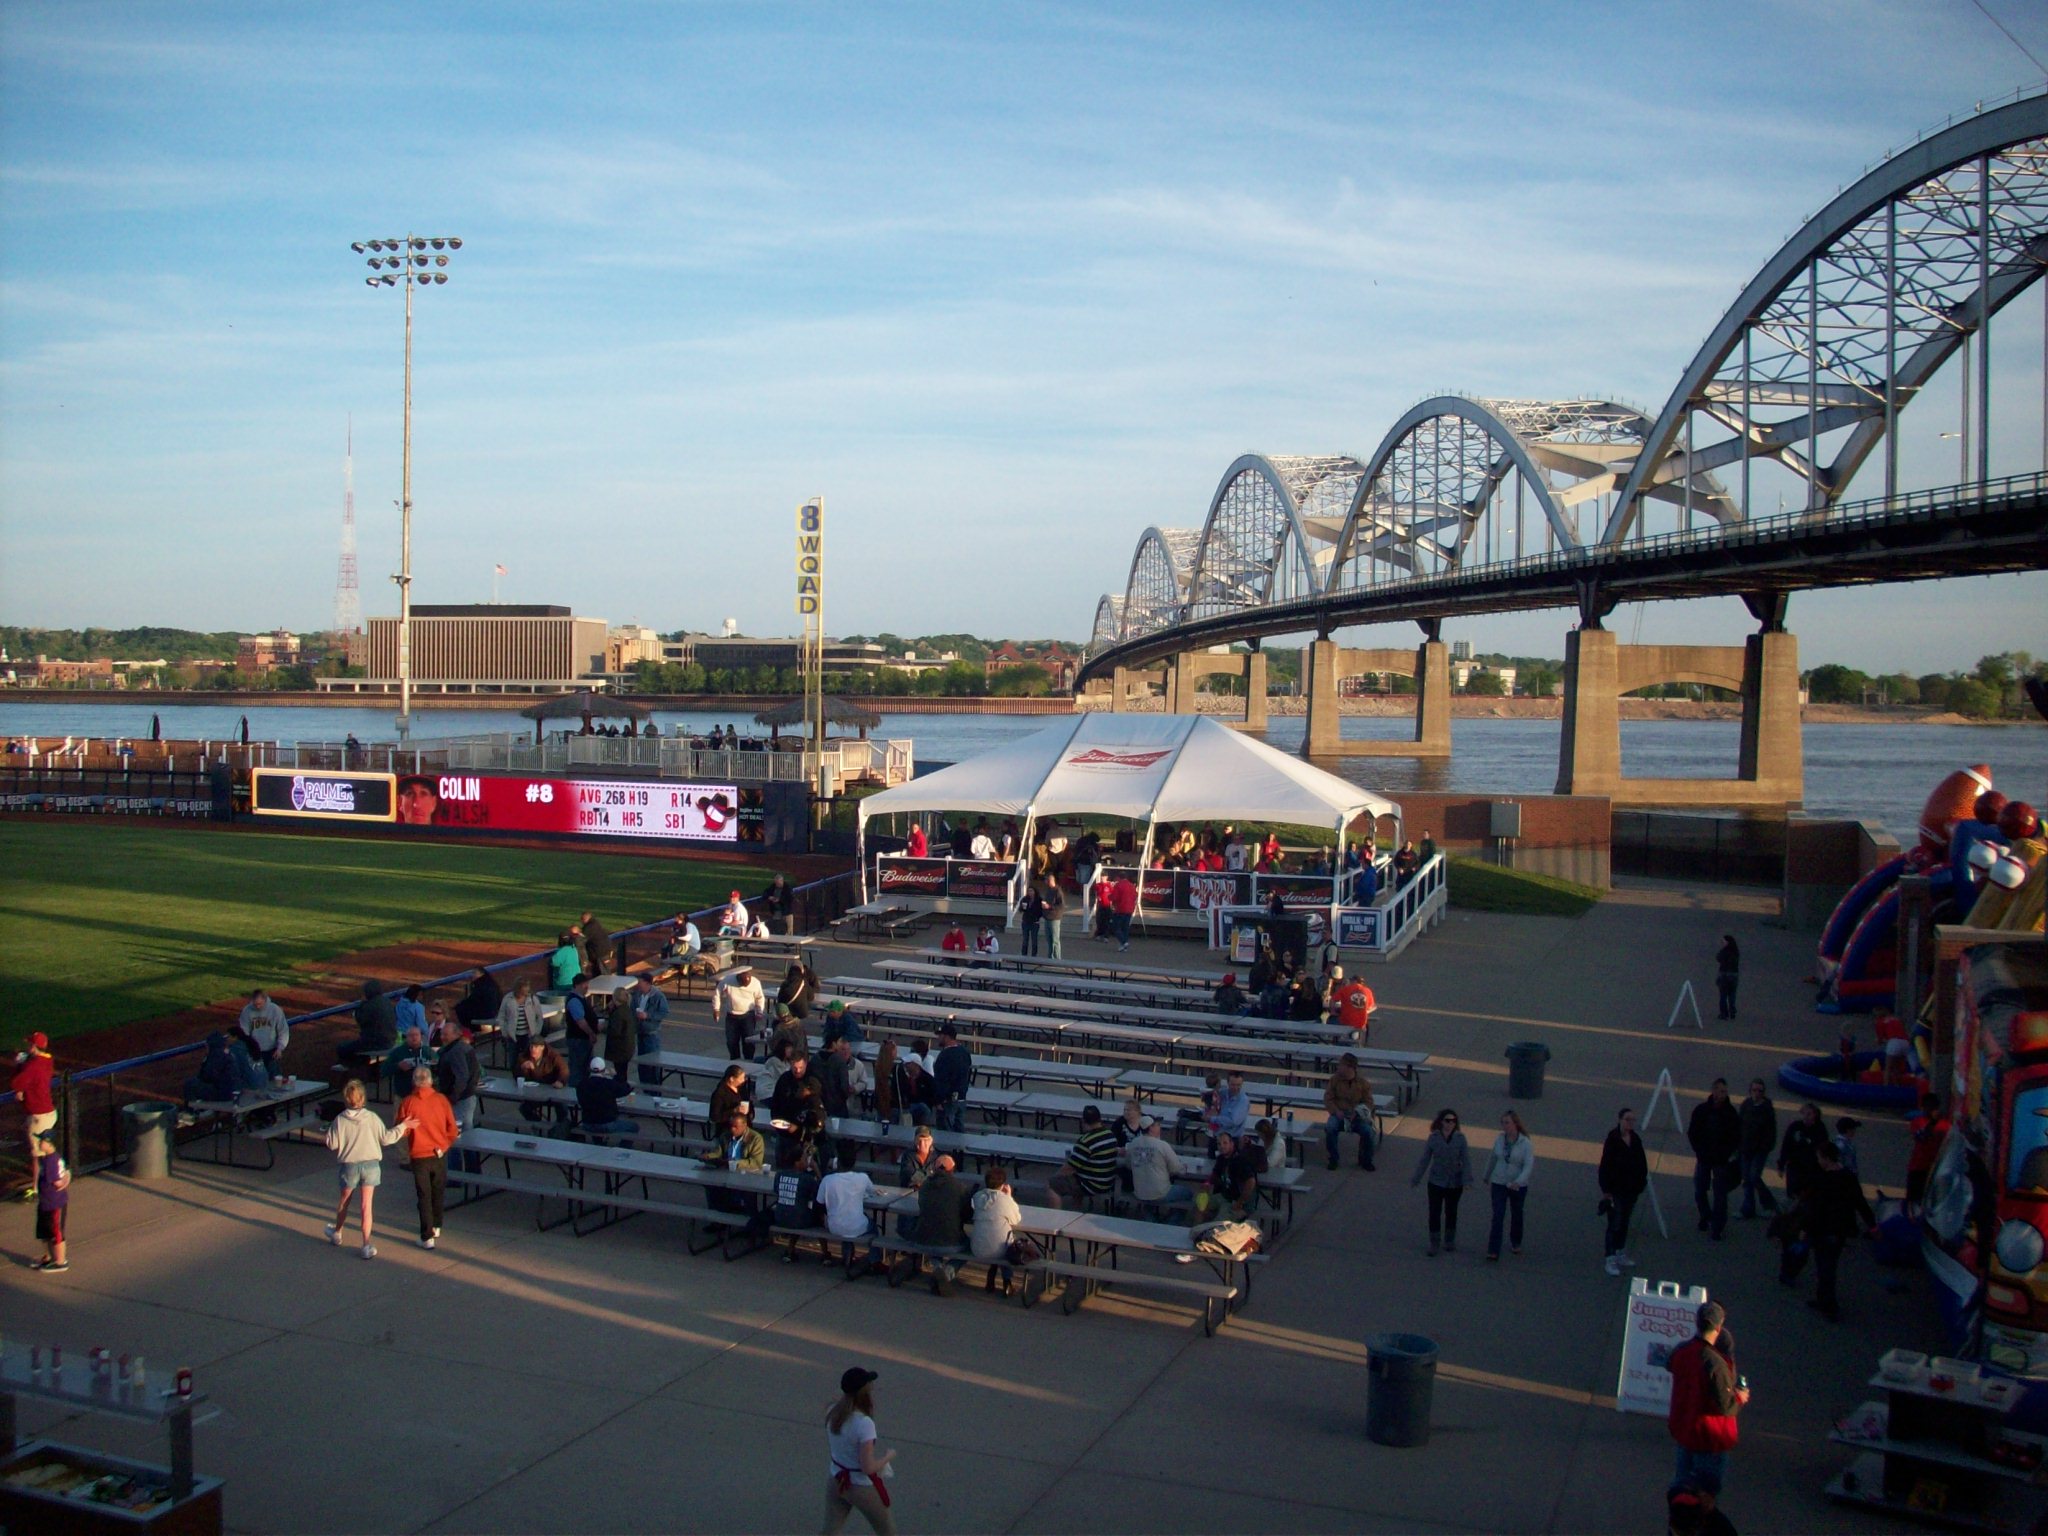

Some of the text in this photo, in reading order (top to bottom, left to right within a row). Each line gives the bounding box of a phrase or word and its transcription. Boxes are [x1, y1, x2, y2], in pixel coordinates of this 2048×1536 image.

[799, 505, 819, 614] 8 WQAD
[1071, 750, 1167, 762] Budweiser
[306, 782, 354, 801] PALMER
[439, 777, 554, 803] COLIN #8
[579, 789, 692, 807] AVG .268 H 19 R 14
[177, 801, 212, 811] ON-DECK!
[439, 802, 489, 824] WALSH
[622, 812, 635, 827] HR
[636, 812, 643, 827] 5
[665, 813, 680, 829] SB
[880, 869, 945, 884] Budweiser
[958, 866, 1007, 878] Budweiser
[1638, 1318, 1691, 1338] Joey's
